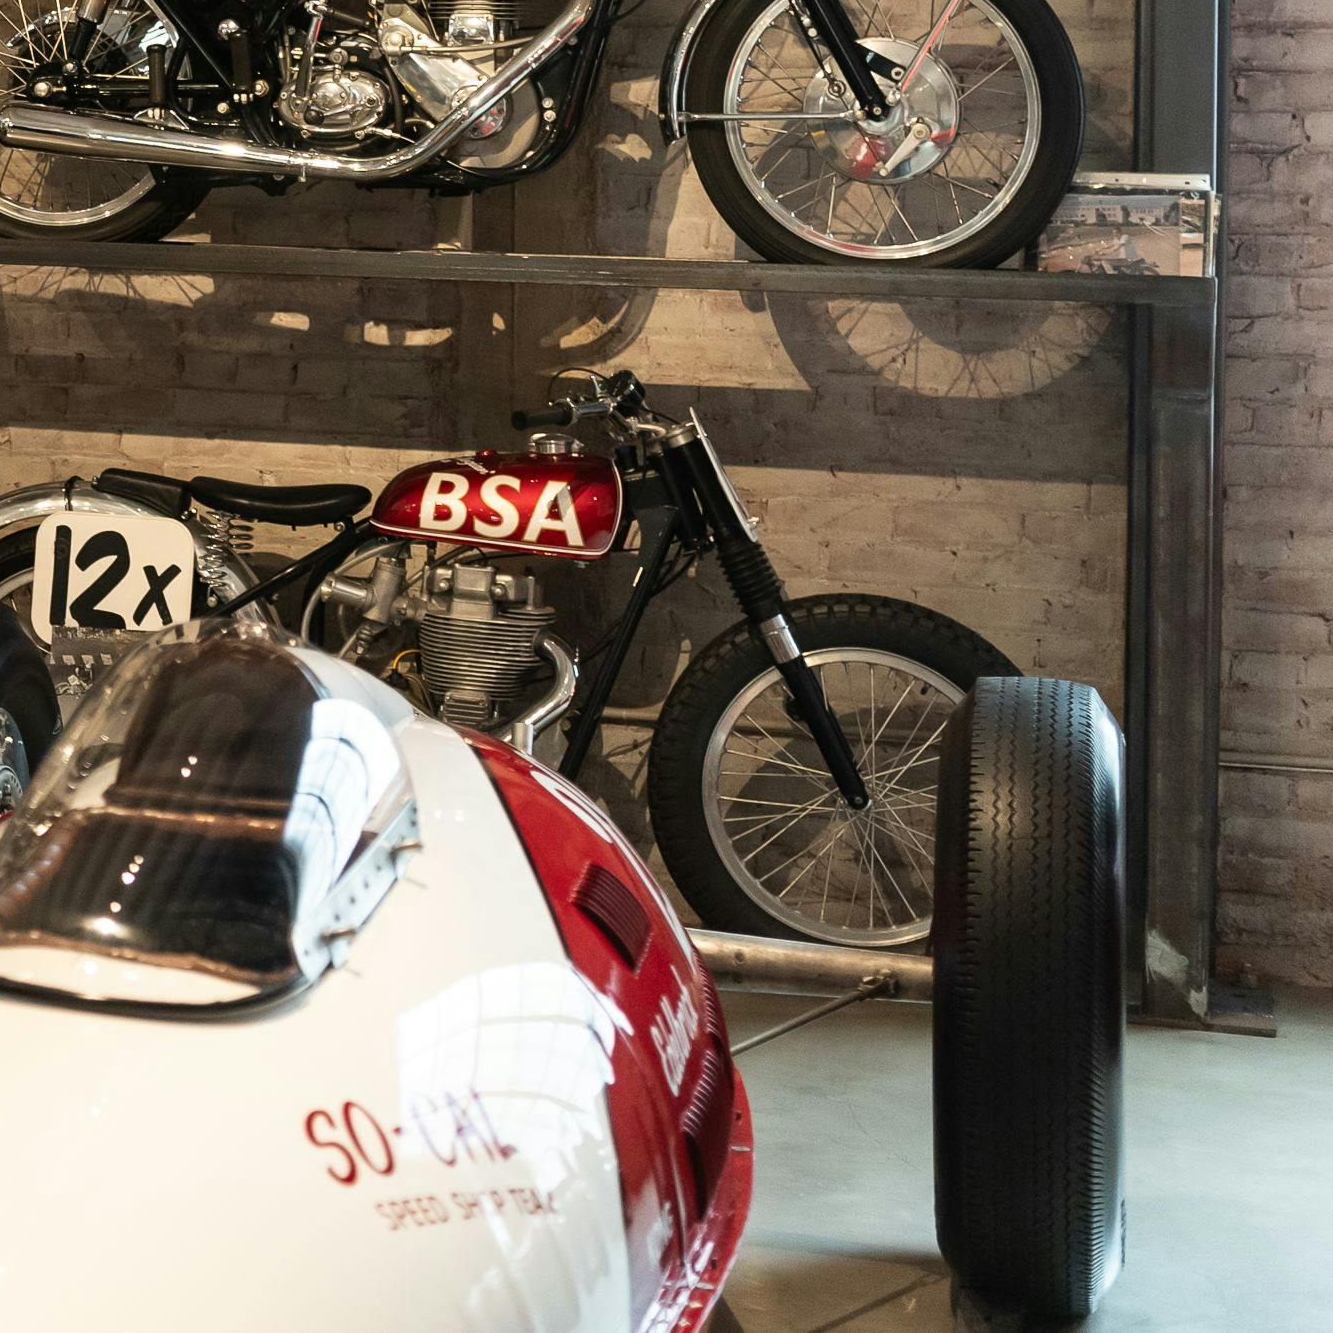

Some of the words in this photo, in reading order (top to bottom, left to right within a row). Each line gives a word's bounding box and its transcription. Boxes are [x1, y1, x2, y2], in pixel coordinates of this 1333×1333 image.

[418, 470, 586, 548] BSA
[305, 1087, 520, 1187] SO-CAL
[375, 1195, 450, 1232] SPEED
[450, 1189, 505, 1221] SHP
